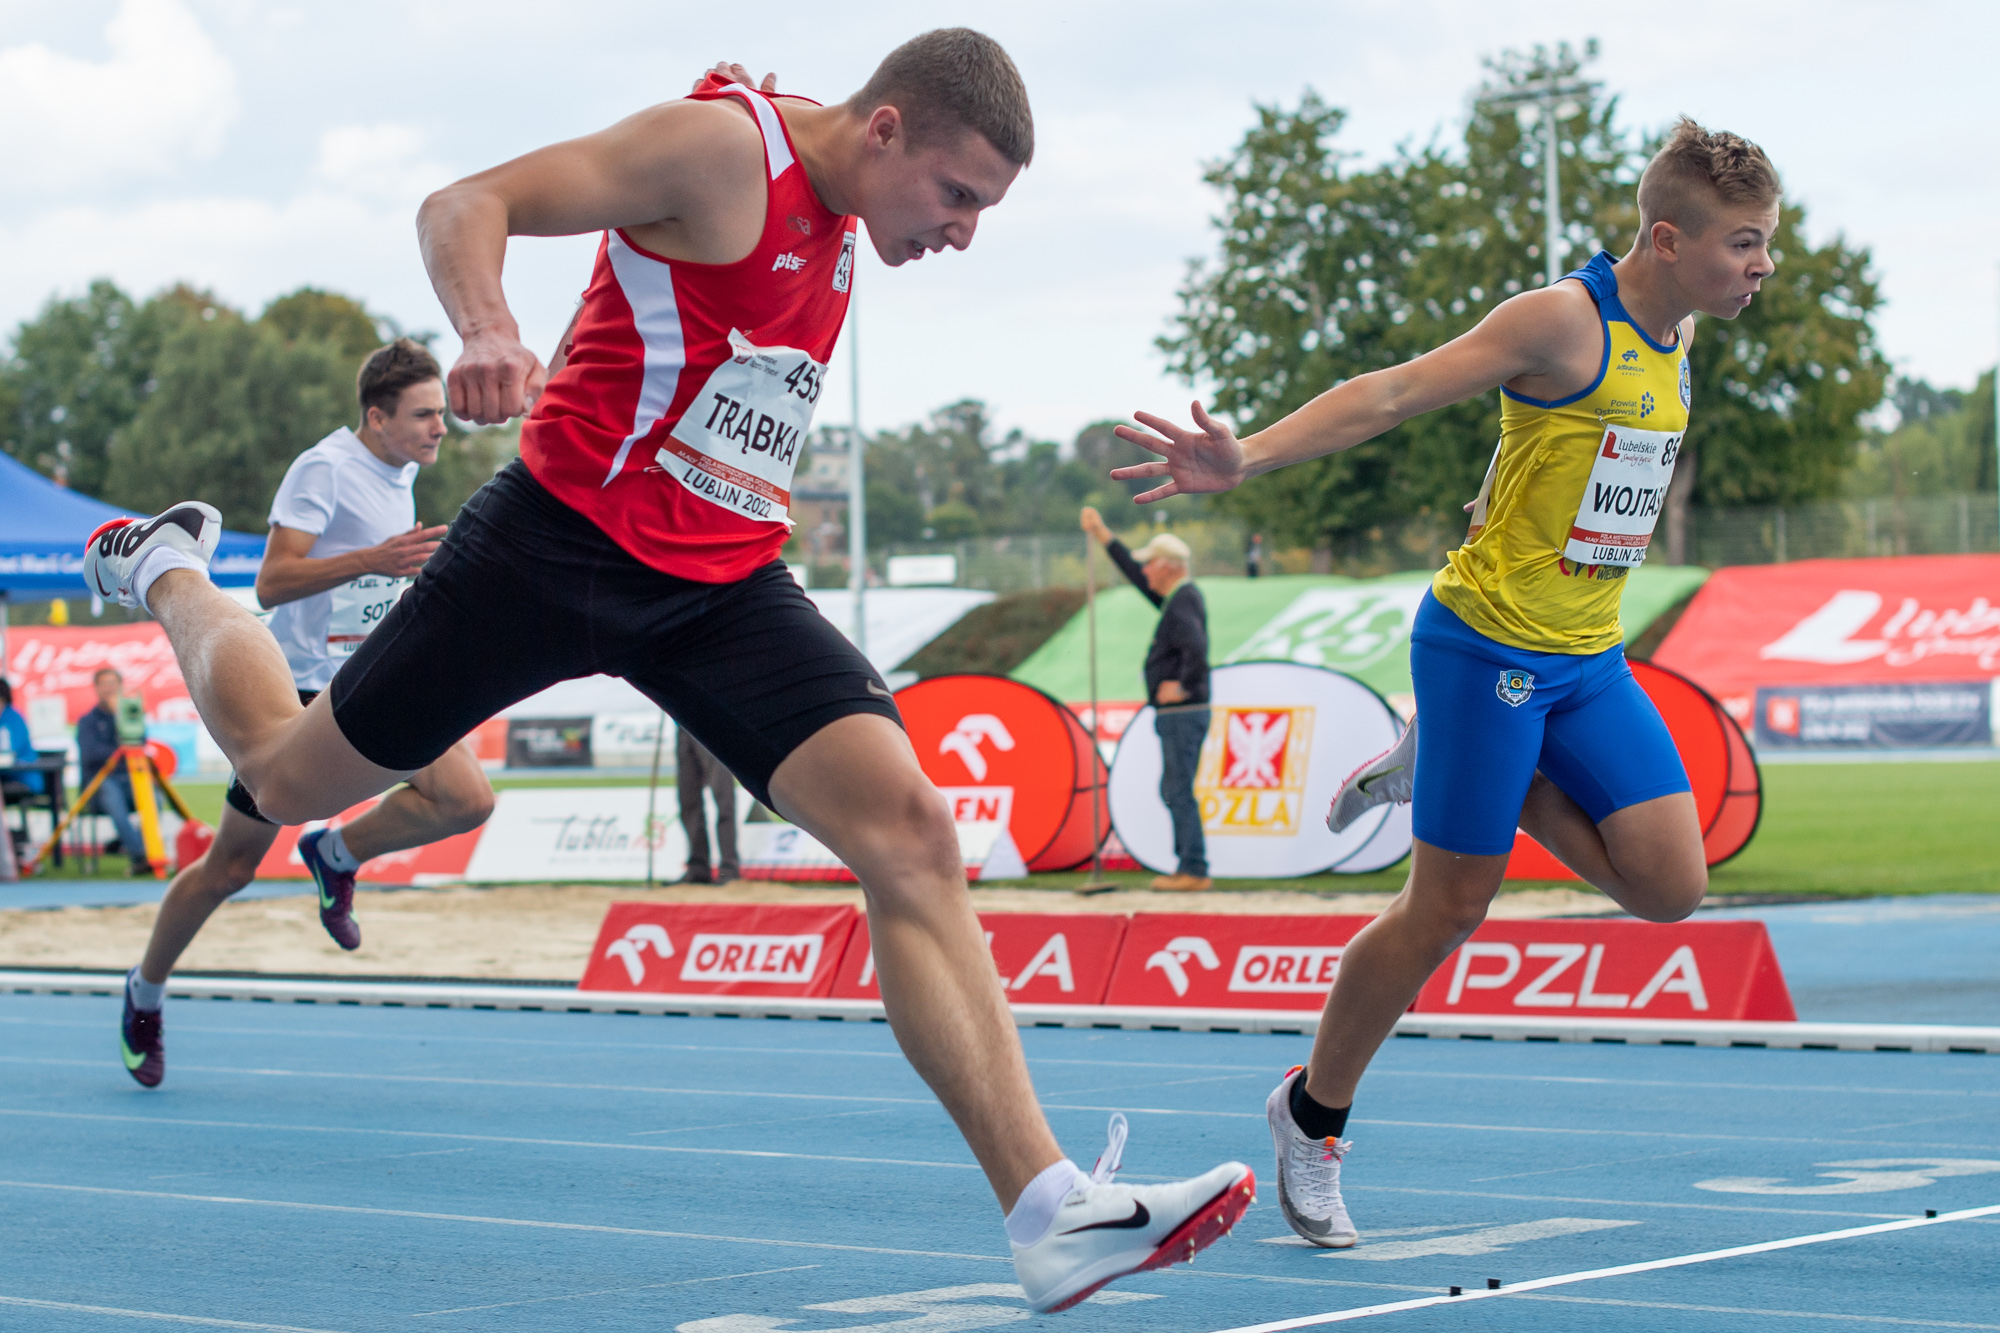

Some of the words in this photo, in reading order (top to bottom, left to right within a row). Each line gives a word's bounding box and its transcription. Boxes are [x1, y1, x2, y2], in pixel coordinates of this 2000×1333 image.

[1594, 407, 1637, 416] Ostrowski
[1610, 400, 1637, 408] Powiat
[705, 392, 799, 466] TRĄBKA
[1618, 438, 1657, 454] lubelskie
[682, 467, 742, 505] LUBLIN
[742, 493, 771, 519] 2022
[1592, 546, 1631, 561] LUBLIN
[361, 598, 394, 624] SOT
[693, 942, 811, 974] ORLEN
[1242, 953, 1339, 984] ORLE
[1446, 942, 1709, 1011] PZLA
